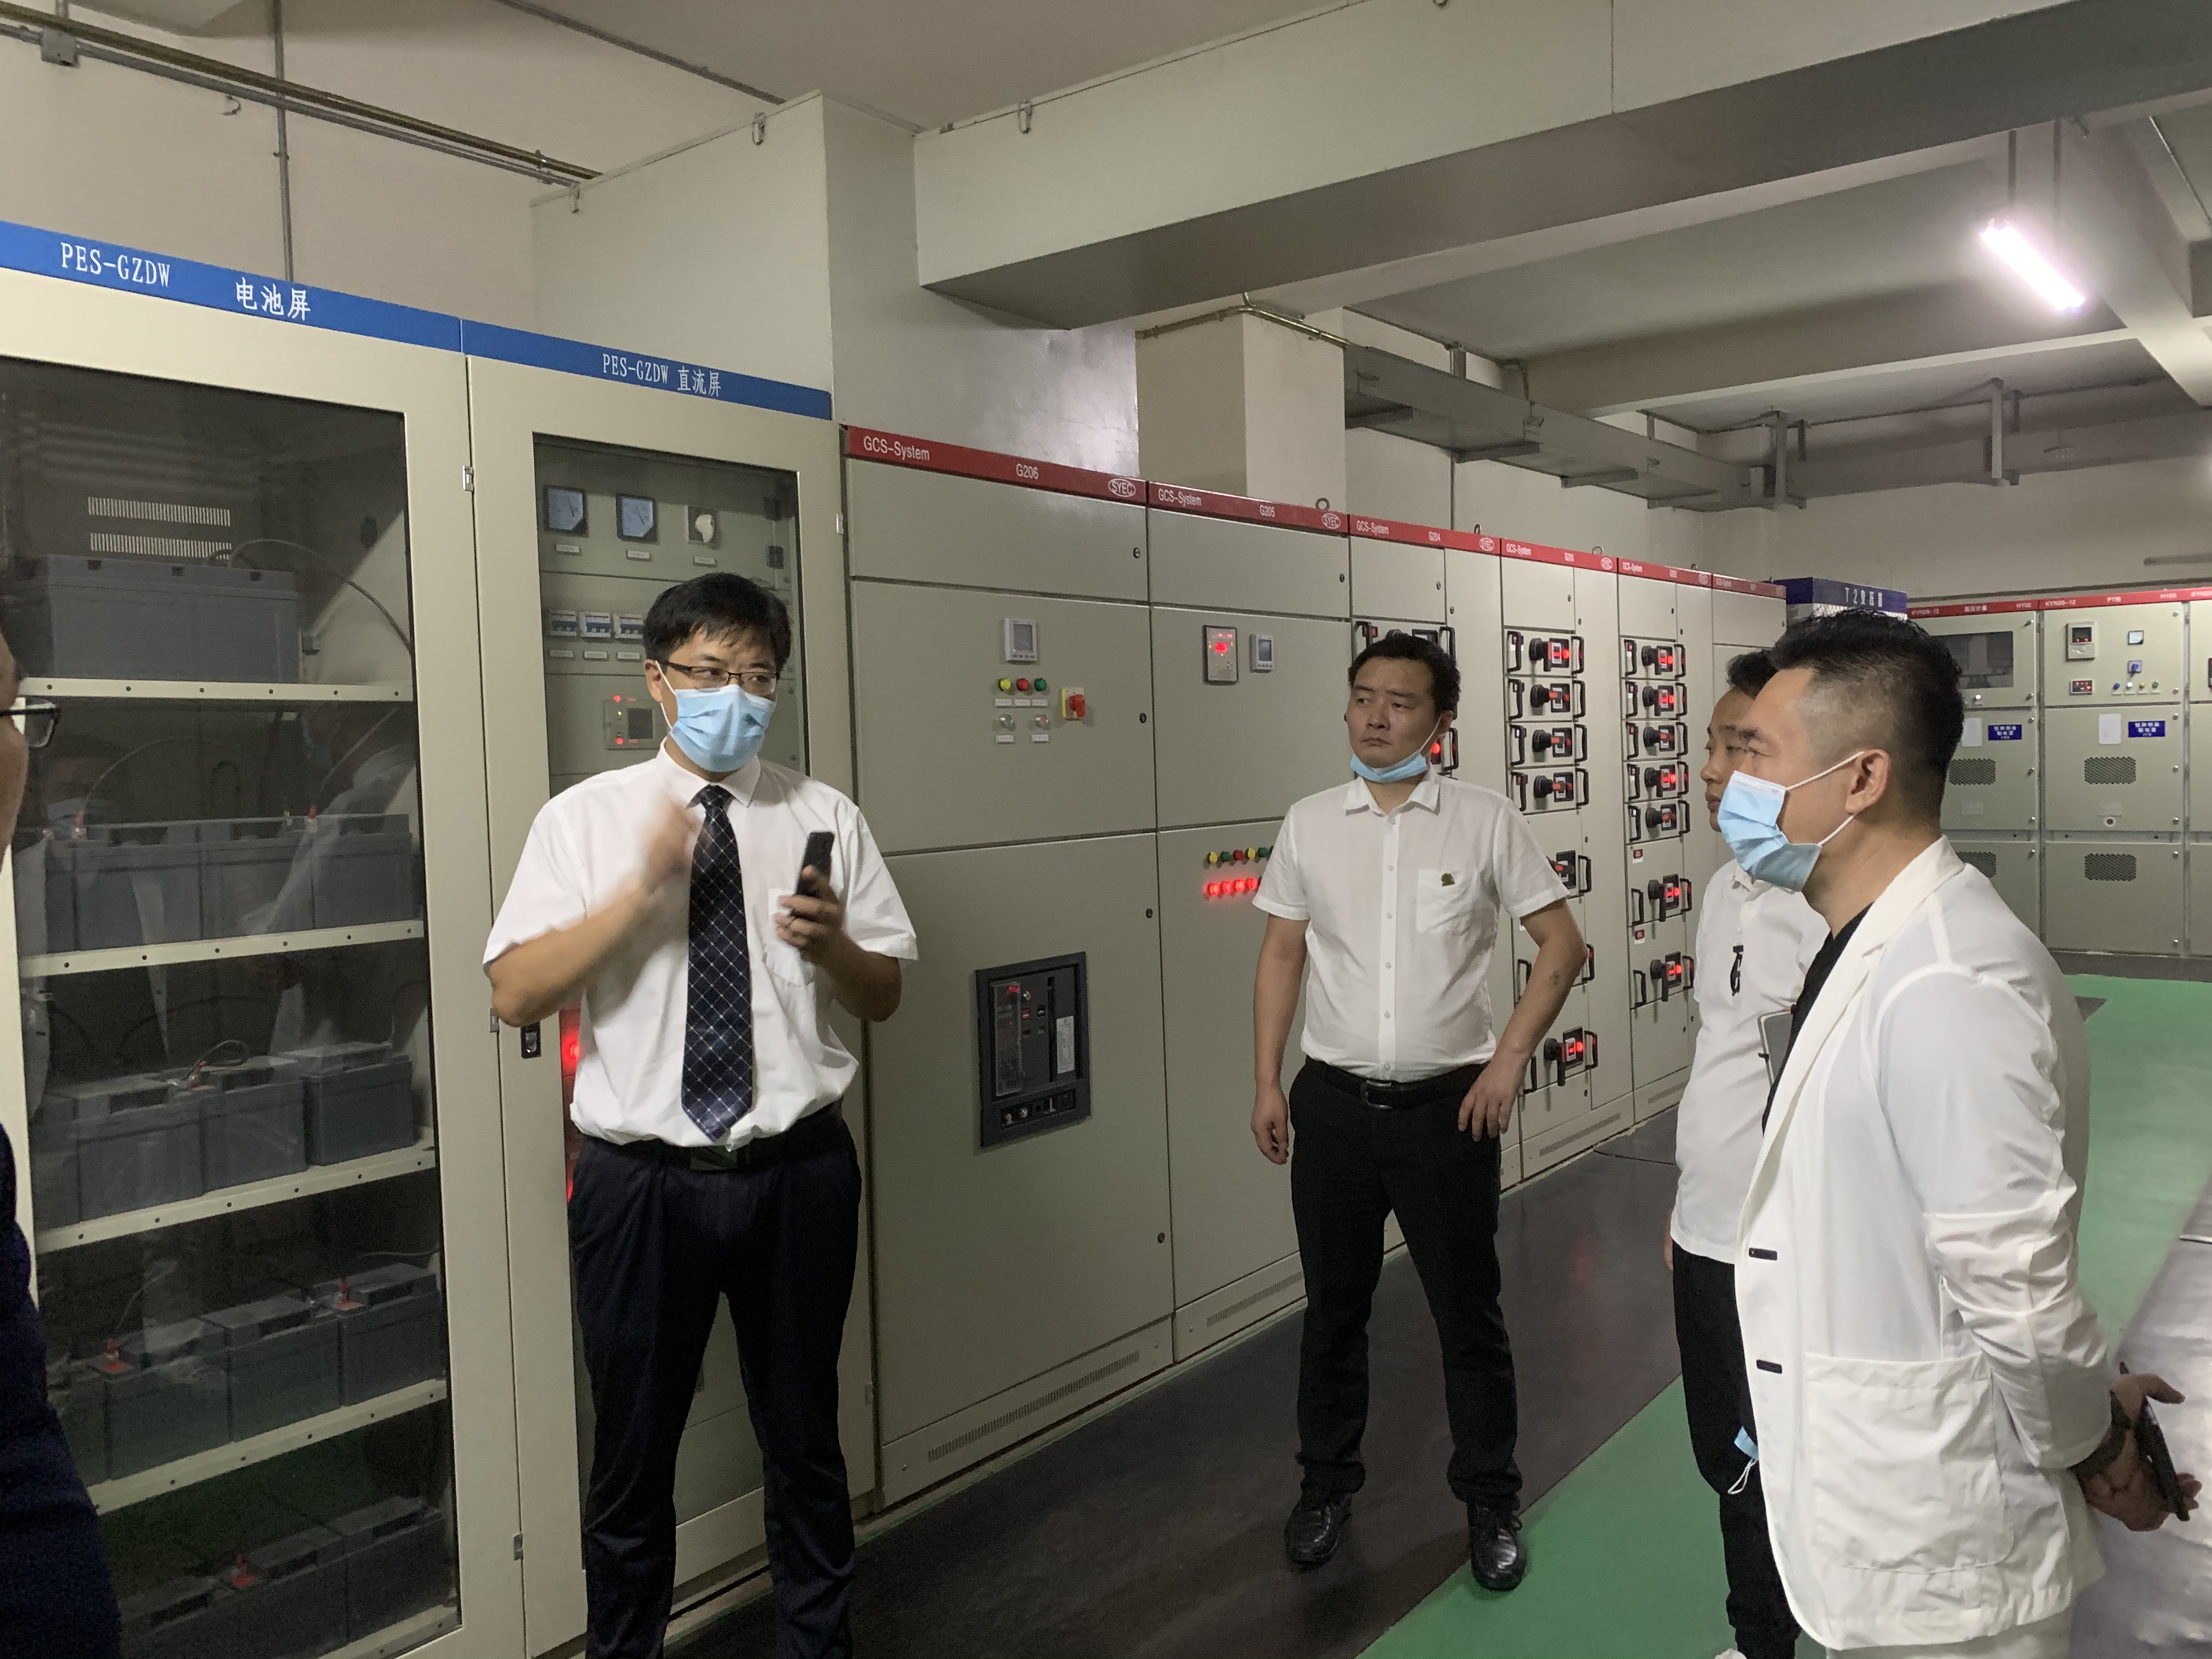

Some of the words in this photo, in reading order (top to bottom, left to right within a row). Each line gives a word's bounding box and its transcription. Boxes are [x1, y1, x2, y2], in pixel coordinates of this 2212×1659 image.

[60, 242, 171, 287] PES-GZDW
[235, 276, 311, 321] 电池屏
[602, 353, 669, 384] PES-GZDW
[676, 365, 721, 397] 直流屏
[863, 436, 930, 462] GCS-System
[1015, 463, 1039, 480] G206
[1110, 479, 1135, 496] SYEC
[1158, 488, 1202, 507] GCS-System
[1259, 505, 1276, 518] G205
[1322, 514, 1340, 528] SYEC
[1356, 520, 1389, 537] GCS-System
[1428, 531, 1441, 542] G204
[1506, 543, 1532, 557] GCS-System
